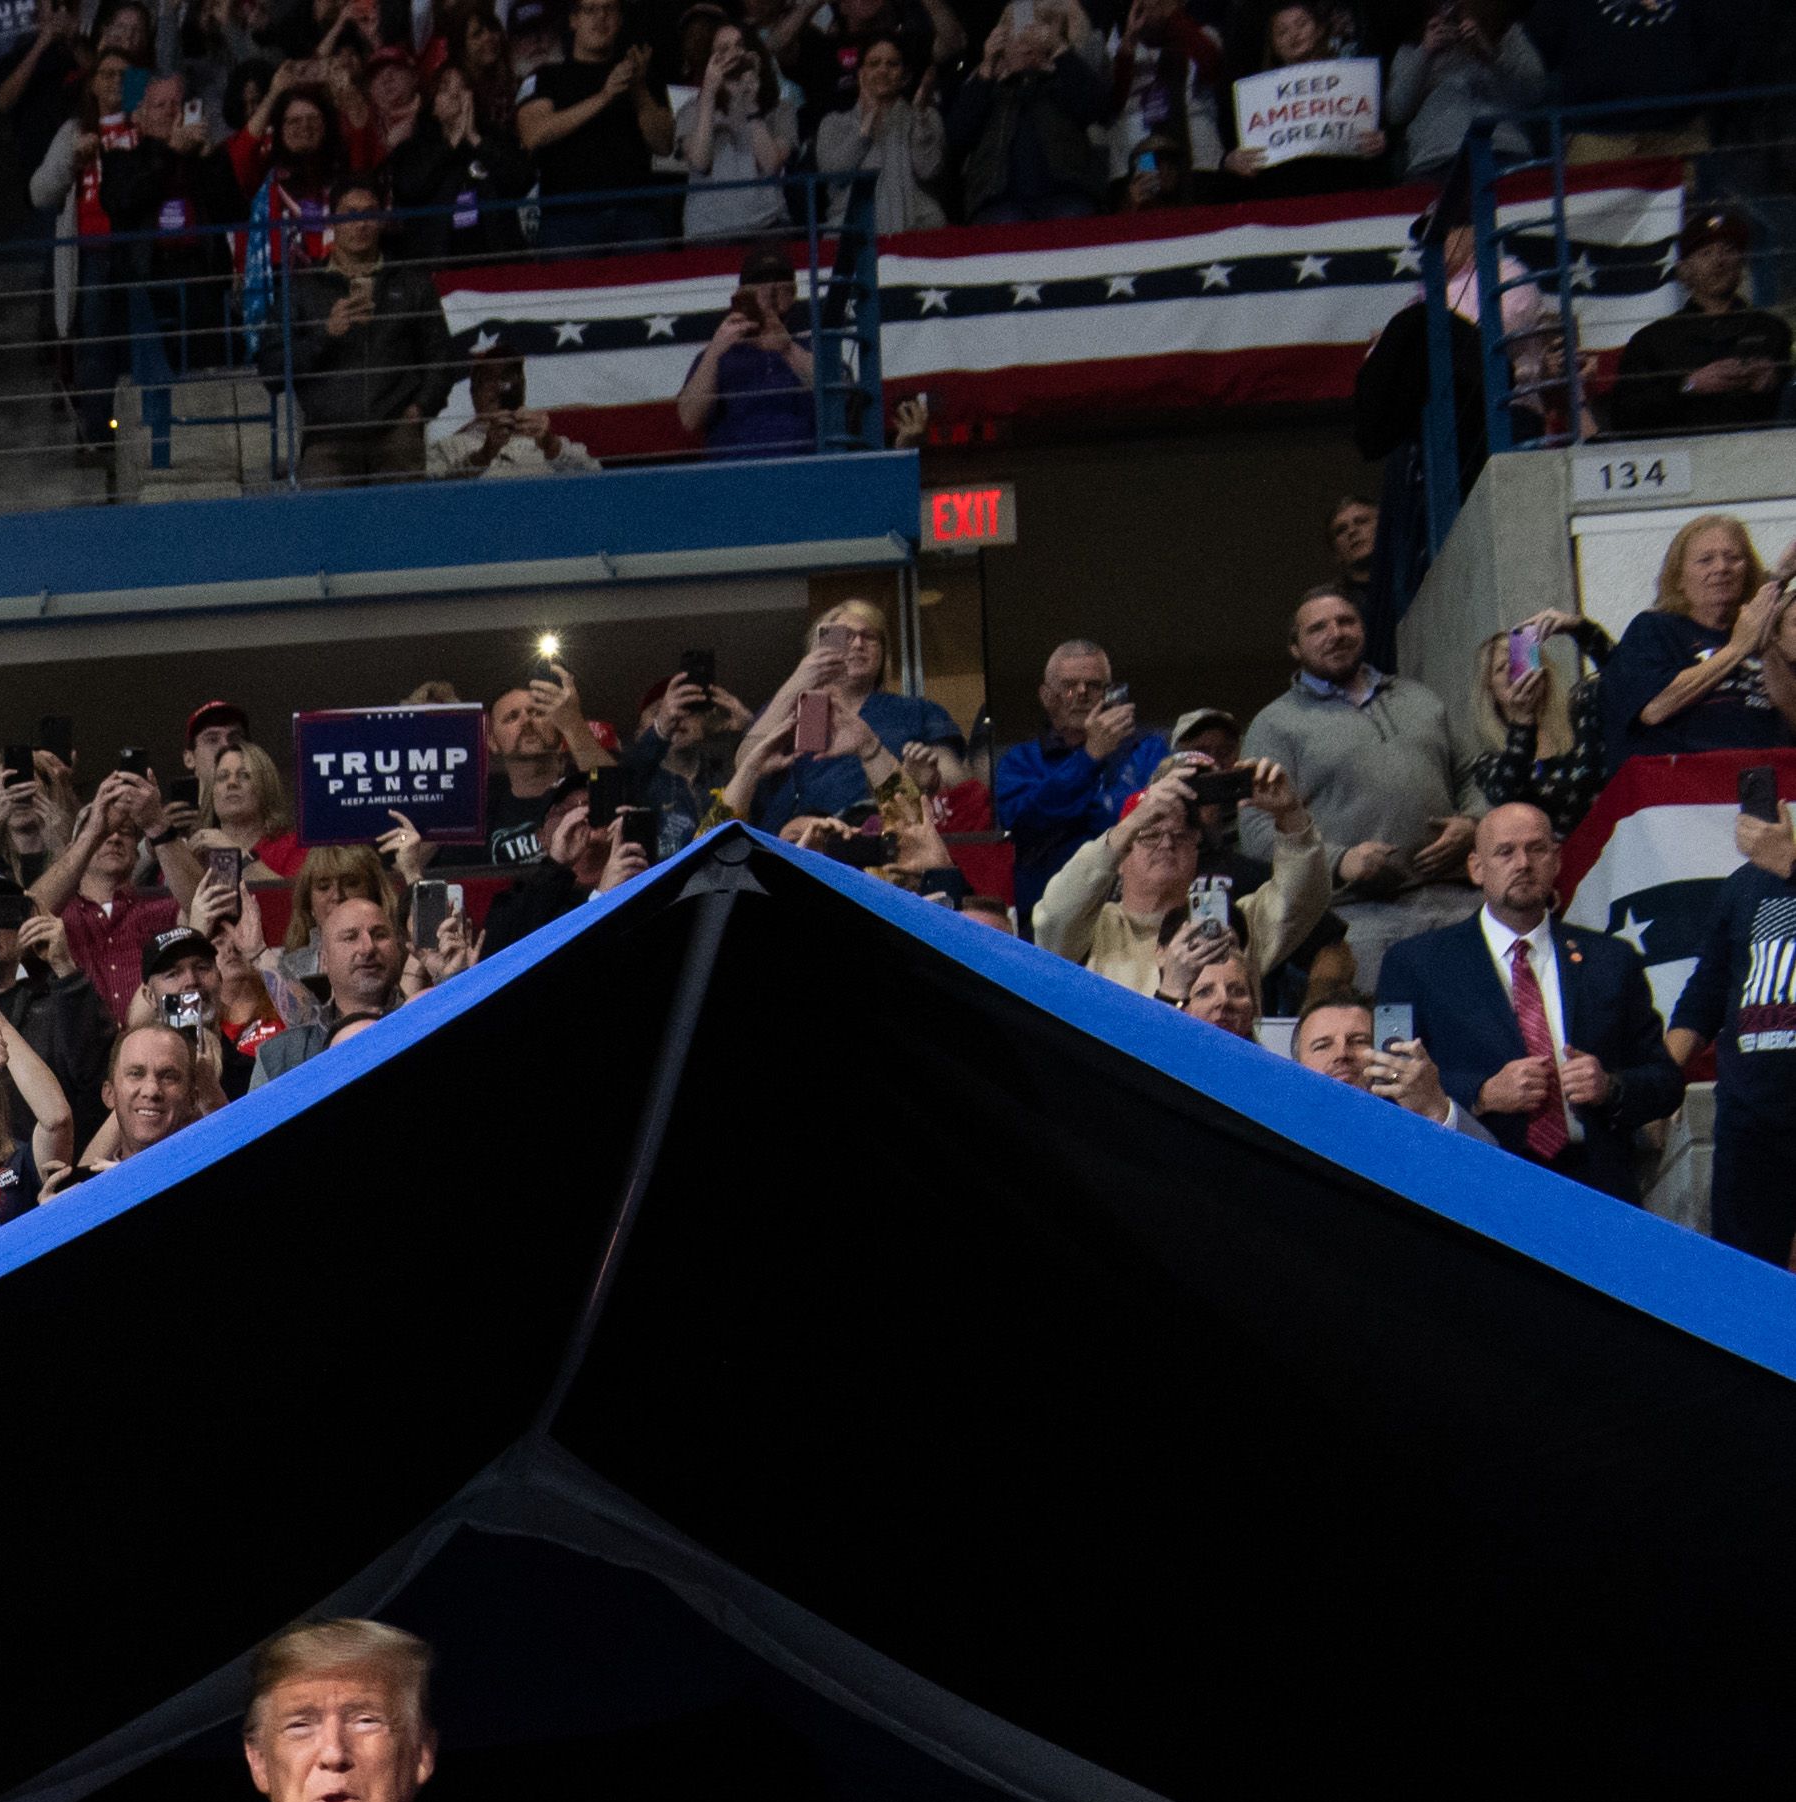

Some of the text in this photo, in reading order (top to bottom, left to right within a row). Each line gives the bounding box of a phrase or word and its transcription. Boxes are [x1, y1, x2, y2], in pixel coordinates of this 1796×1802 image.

[1277, 76, 1340, 99] KEEP
[1247, 97, 1371, 132] AMERICA
[1269, 120, 1357, 149] GREAT!
[1599, 459, 1667, 491] 134
[932, 490, 1002, 541] EXIT
[312, 747, 470, 777] TRUMP
[328, 773, 456, 797] PENCE
[340, 793, 445, 807] KEEP AMERICA GREAT!
